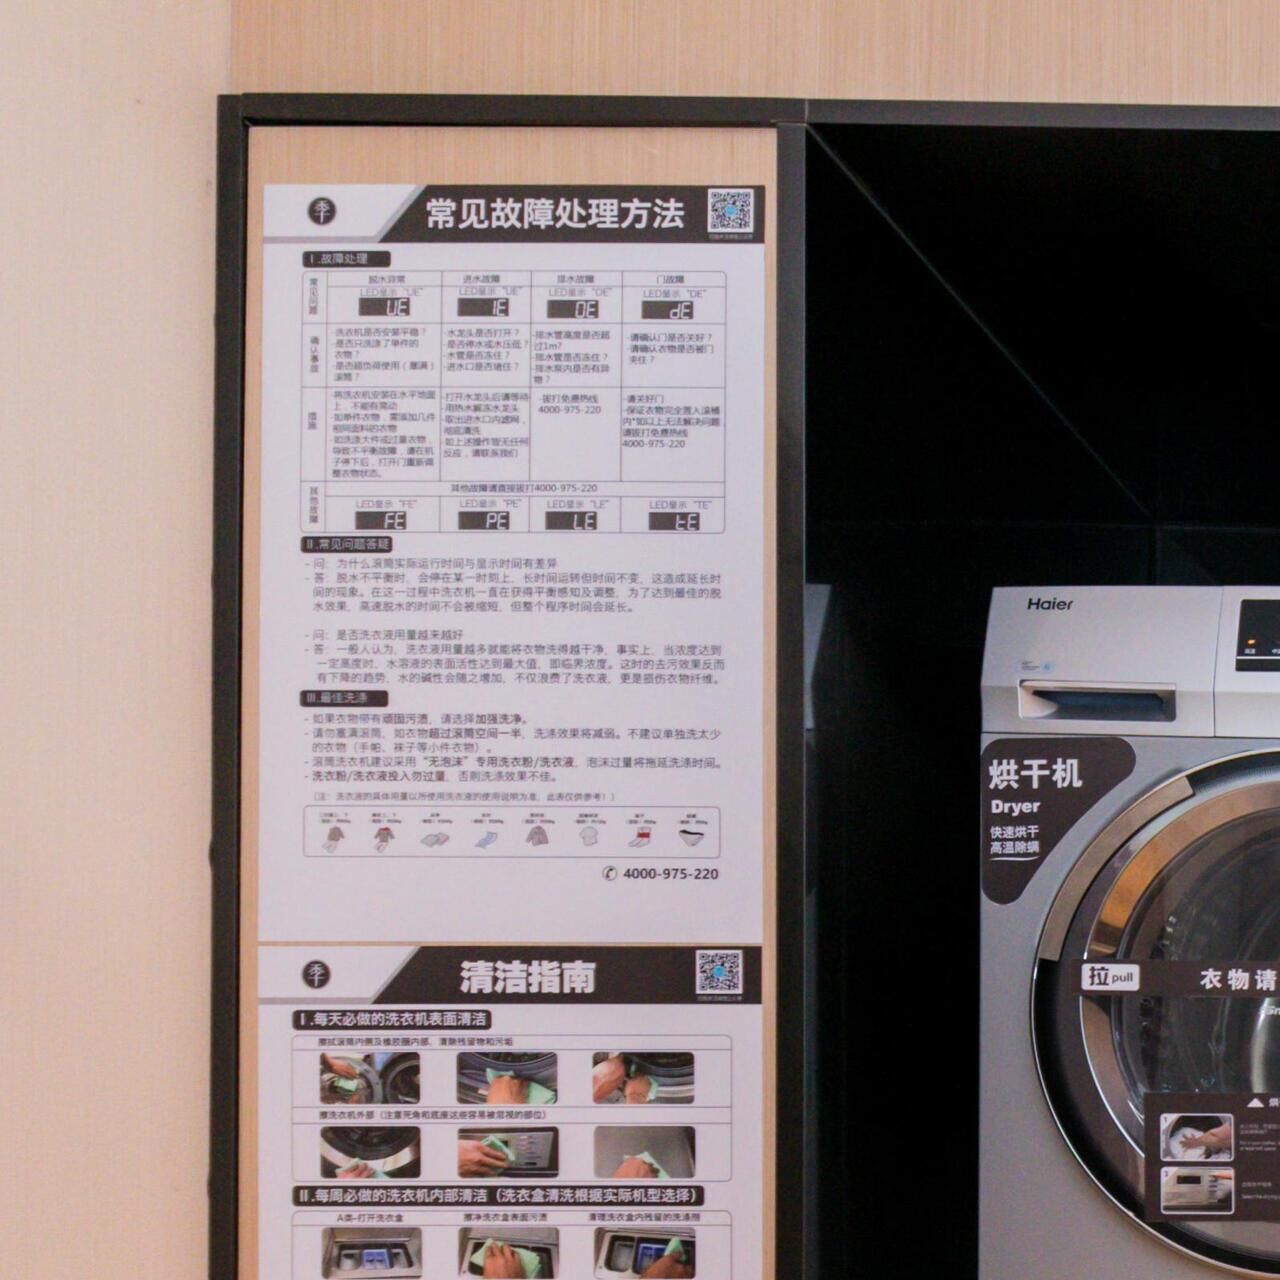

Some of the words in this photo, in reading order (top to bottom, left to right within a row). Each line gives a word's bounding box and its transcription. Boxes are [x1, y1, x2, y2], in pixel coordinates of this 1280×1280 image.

[425, 198, 686, 230] 常见故障处理方法
[386, 299, 408, 316] UE
[538, 406, 602, 414] 4000-975-220
[622, 440, 686, 448] 4000-975-220
[384, 512, 405, 530] FE
[486, 512, 508, 530] PE
[1026, 597, 1074, 611] Haier
[988, 758, 1083, 790] 烘干机
[991, 800, 1040, 817] Dryer
[990, 825, 1040, 839] 快速烘干
[623, 868, 720, 880] 4000-975-220
[459, 958, 597, 995] 清洁指南
[1088, 966, 1109, 986] 拉
[1112, 971, 1134, 985] pull
